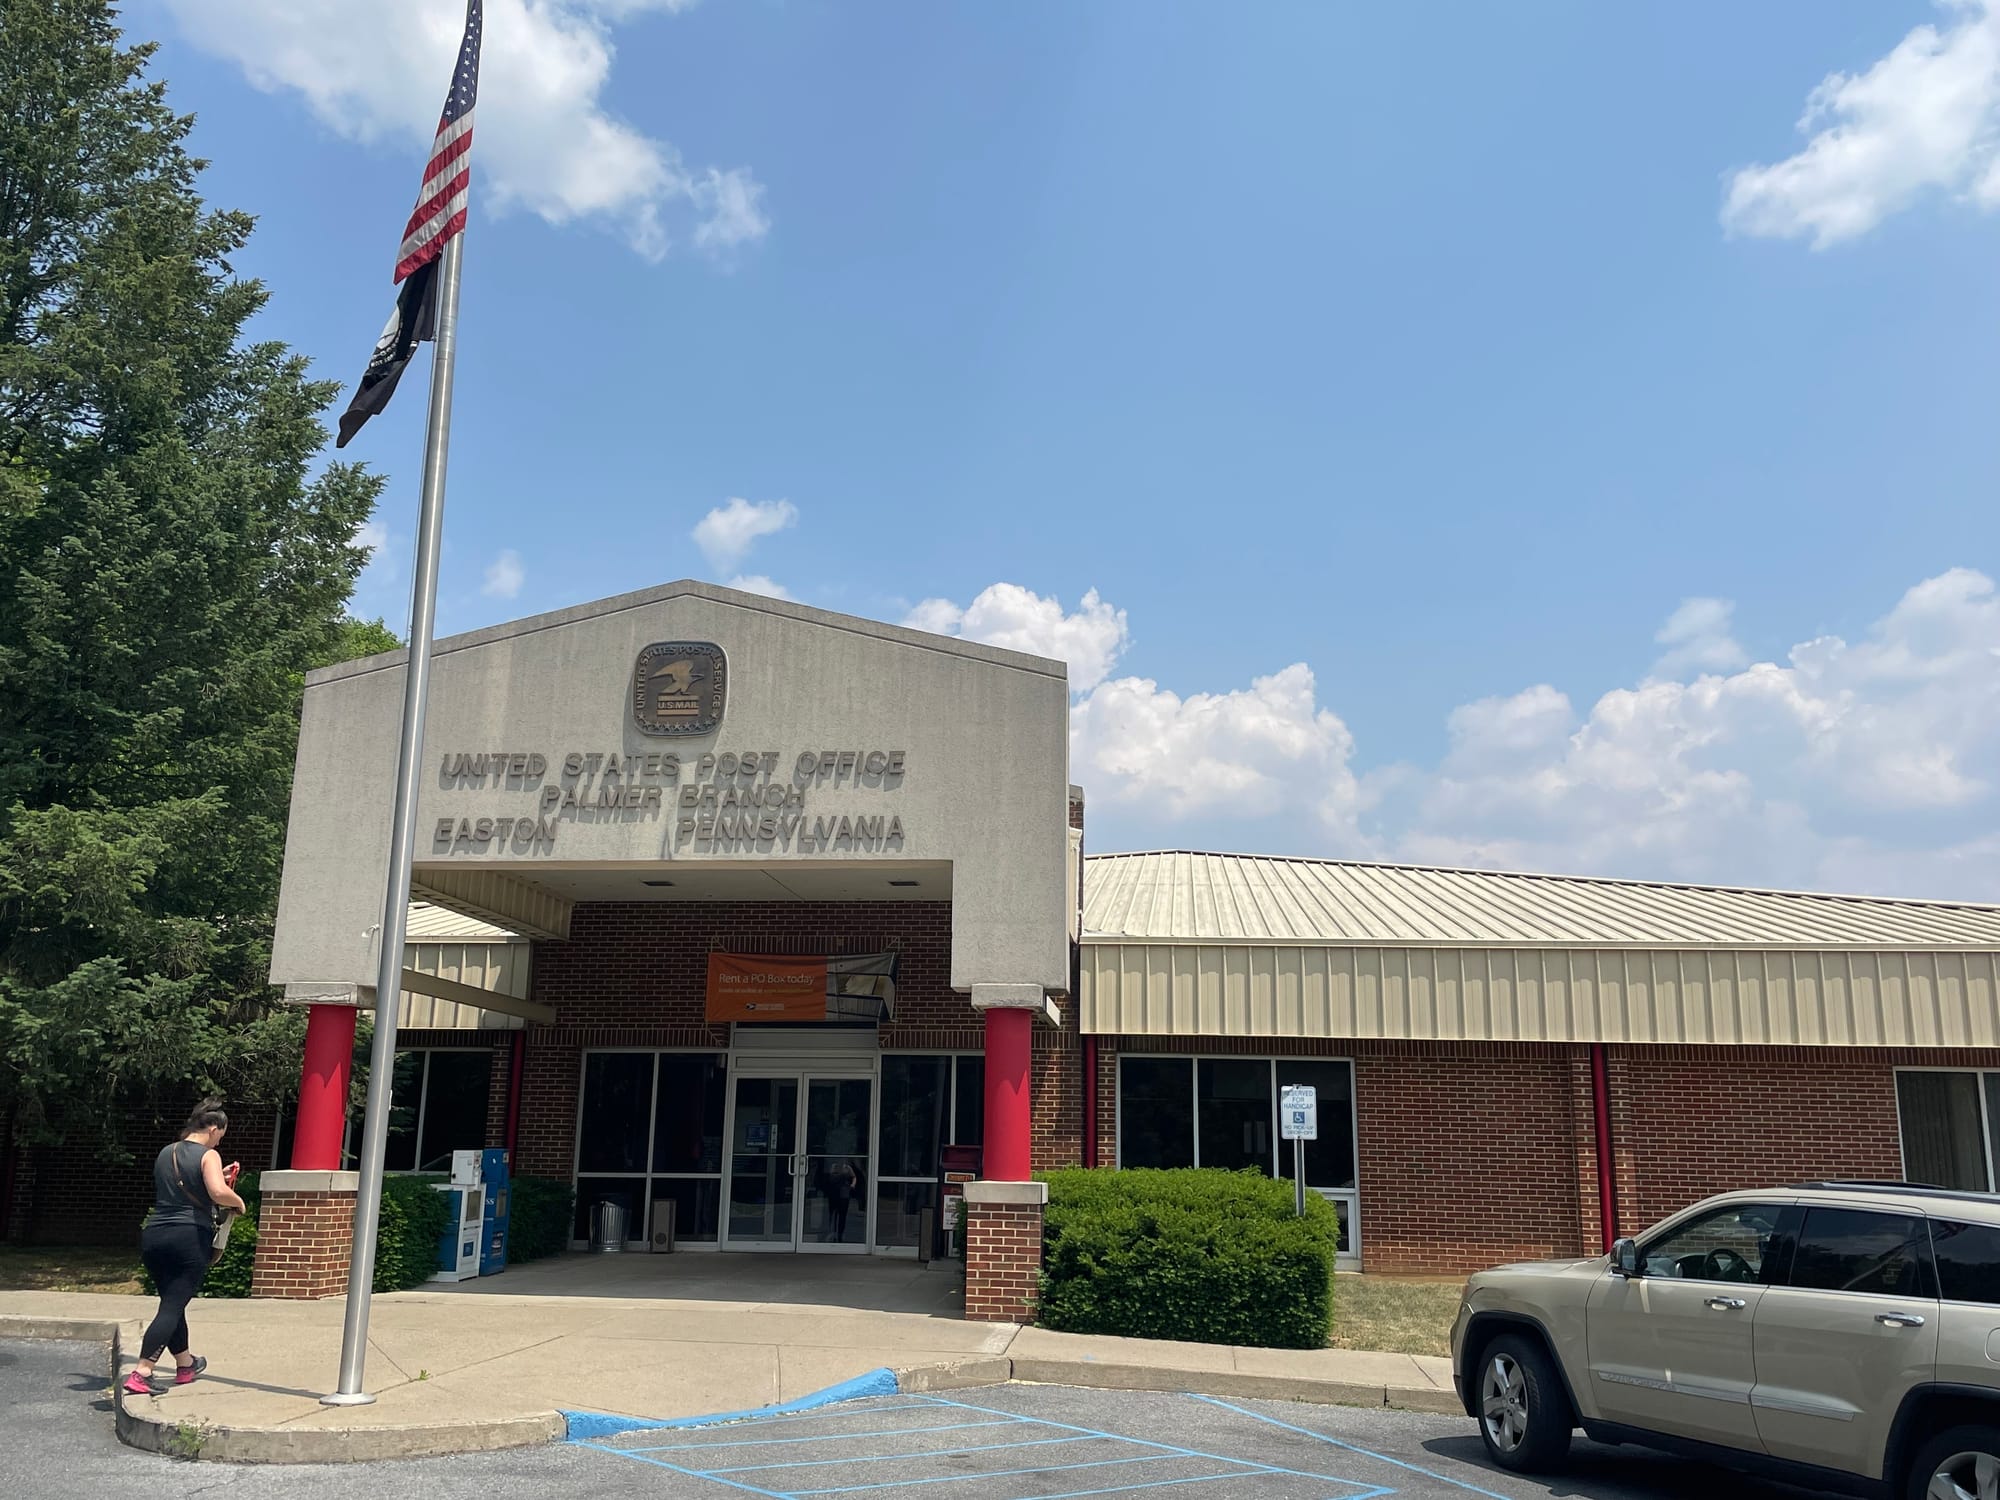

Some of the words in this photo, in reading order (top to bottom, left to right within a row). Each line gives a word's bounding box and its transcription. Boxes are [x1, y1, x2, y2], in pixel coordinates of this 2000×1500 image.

[640, 646, 676, 666] STATES
[636, 668, 647, 709] UNITED
[712, 661, 722, 708] SERVICE
[443, 752, 547, 777] UNITED
[563, 752, 681, 777] STATES
[697, 751, 779, 776] POST
[797, 750, 906, 775] OFFICE
[542, 784, 662, 808] PALMER
[681, 784, 806, 808] BRANCH
[436, 817, 558, 841] EASTON
[678, 815, 906, 840] PENNSYLVANIA
[719, 973, 741, 983] Rent
[751, 974, 766, 983] PO
[767, 974, 785, 983] Box
[787, 973, 815, 985] today
